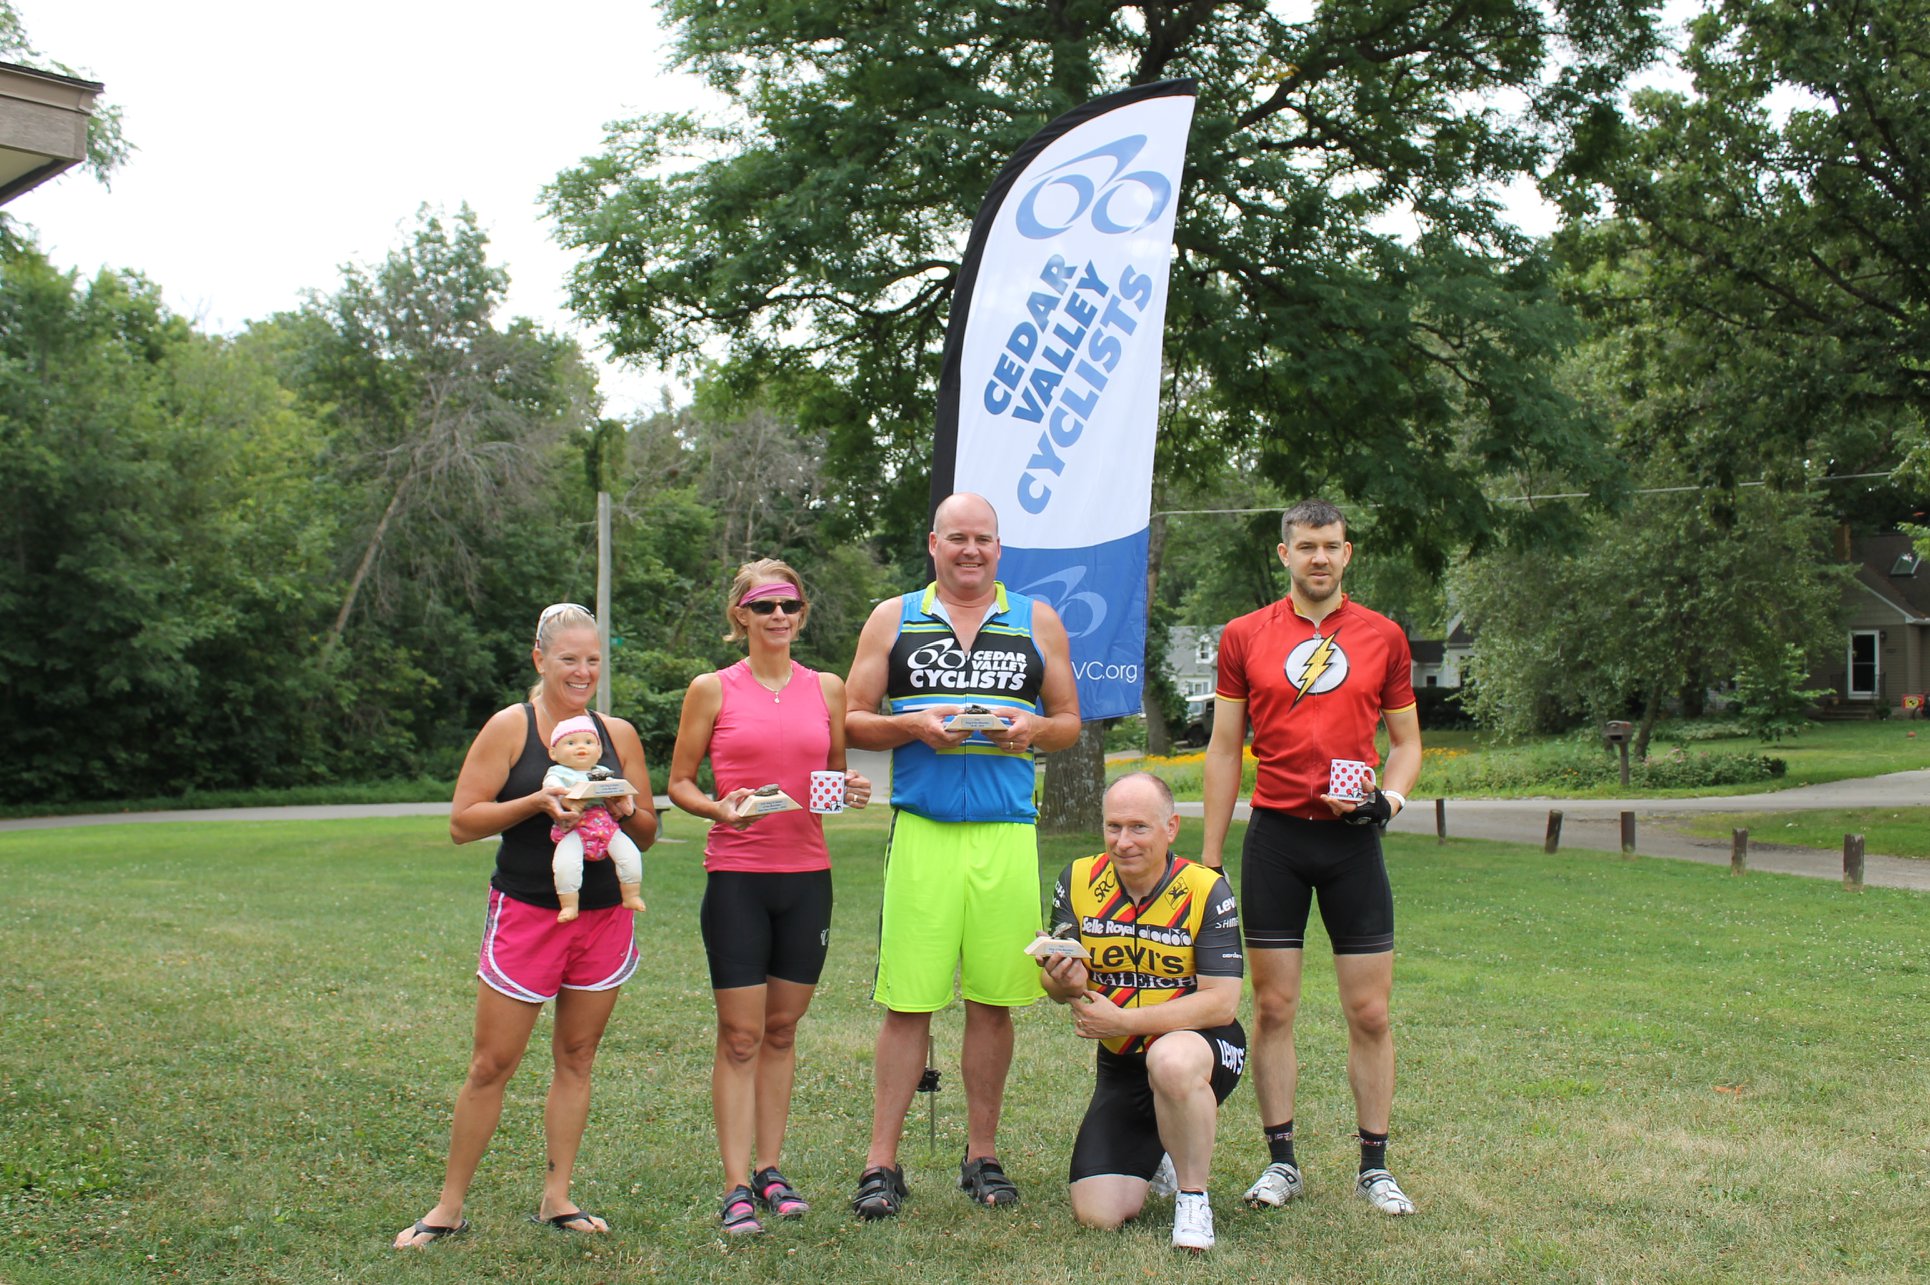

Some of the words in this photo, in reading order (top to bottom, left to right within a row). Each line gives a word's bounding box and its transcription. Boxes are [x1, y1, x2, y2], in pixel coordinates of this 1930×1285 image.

[984, 254, 1078, 415] CEDAR
[1011, 259, 1109, 424] VALLEY
[1017, 264, 1152, 514] CYCLISTS
[971, 660, 1027, 673] VALLEY
[973, 651, 1026, 663] CEDAR
[910, 669, 1026, 691] CYCLISTS
[1082, 917, 1104, 934] Selle
[1105, 920, 1135, 936] Royal
[1138, 925, 1192, 946] diadora
